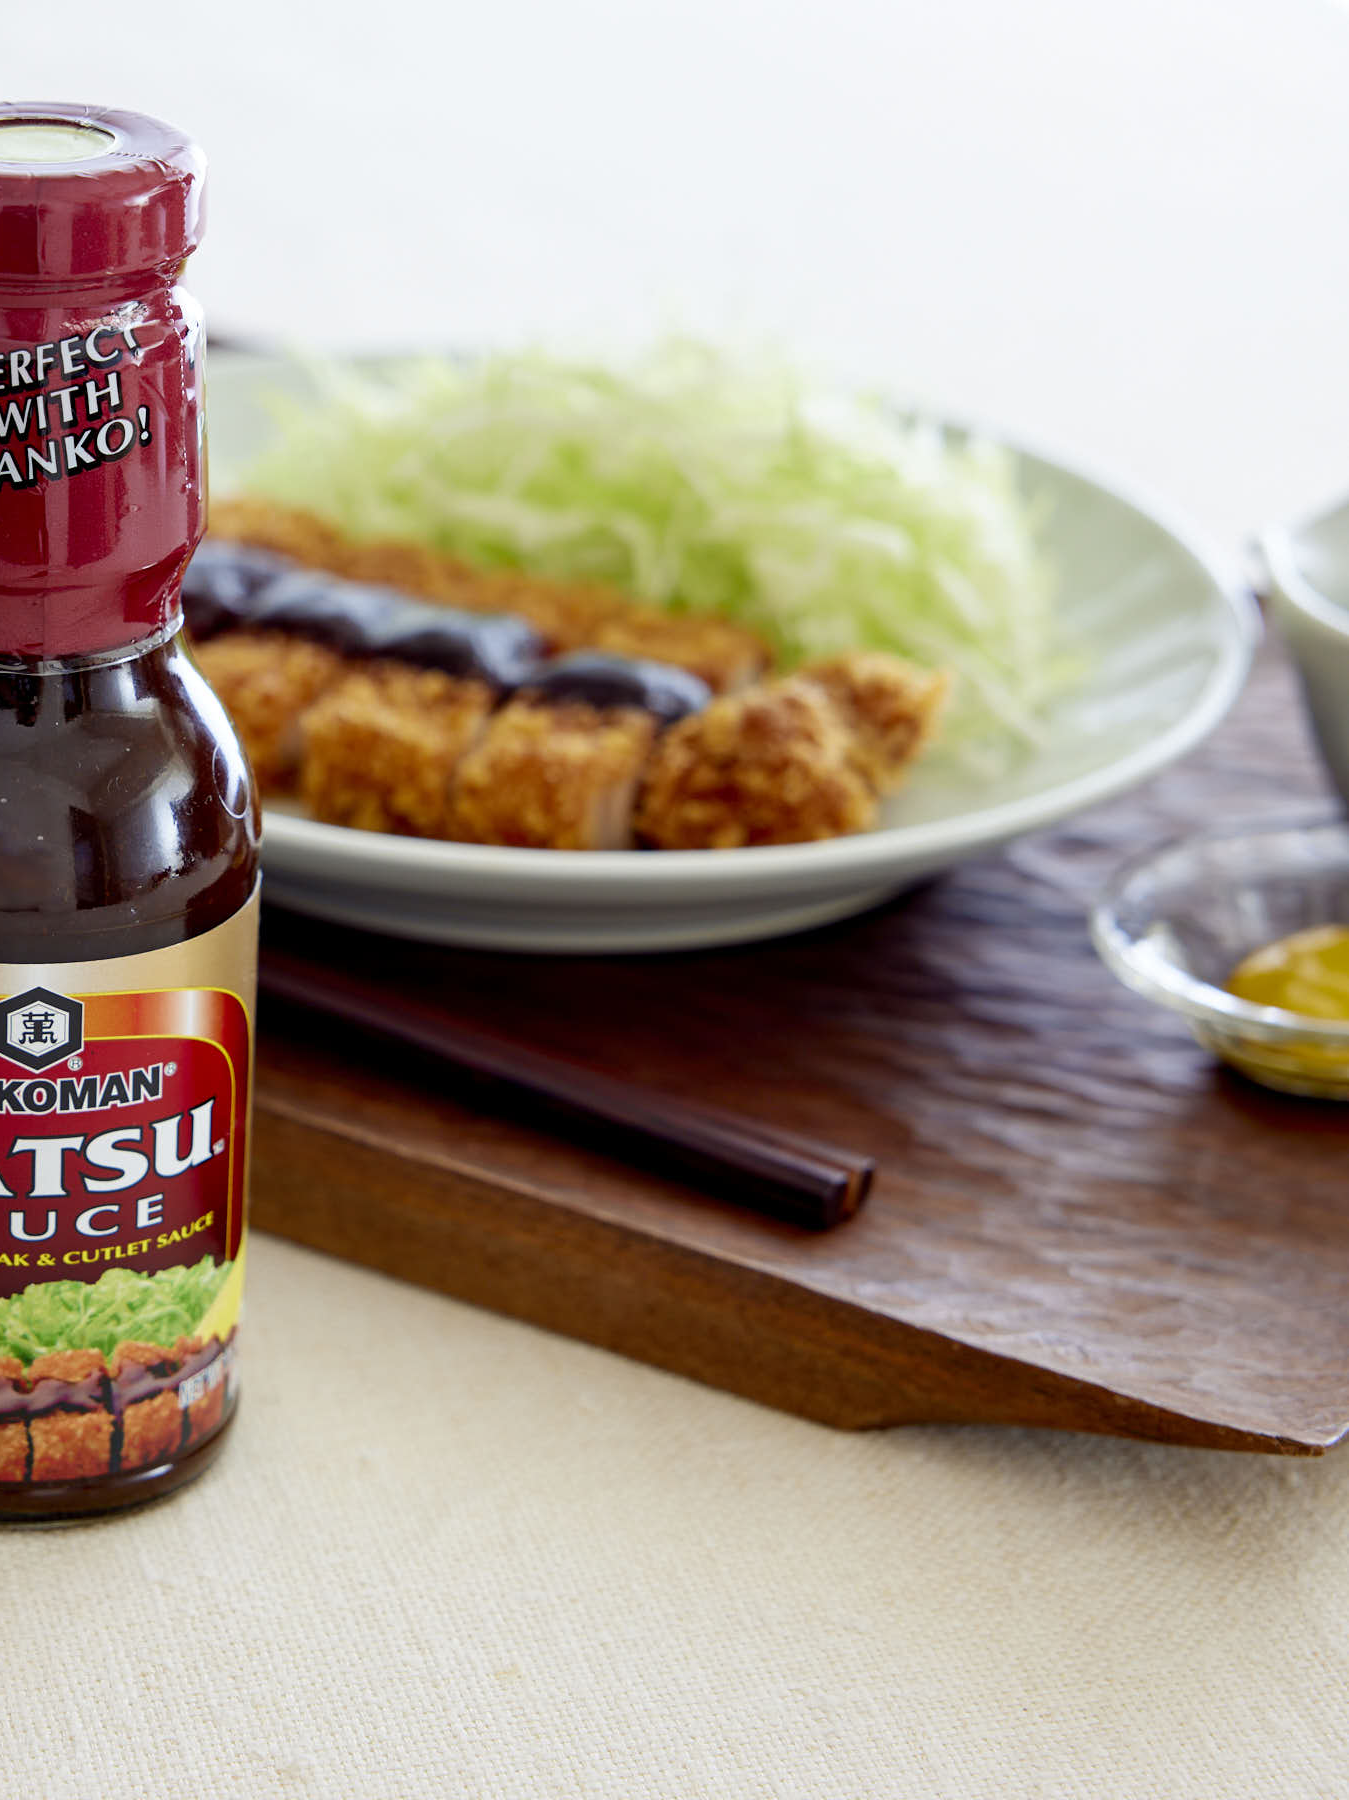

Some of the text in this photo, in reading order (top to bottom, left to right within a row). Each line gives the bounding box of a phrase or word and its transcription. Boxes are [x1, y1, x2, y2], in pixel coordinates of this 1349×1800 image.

[37, 1253, 57, 1267] &
[62, 1238, 152, 1265] CUTLET
[156, 1211, 215, 1249] SAUCE
